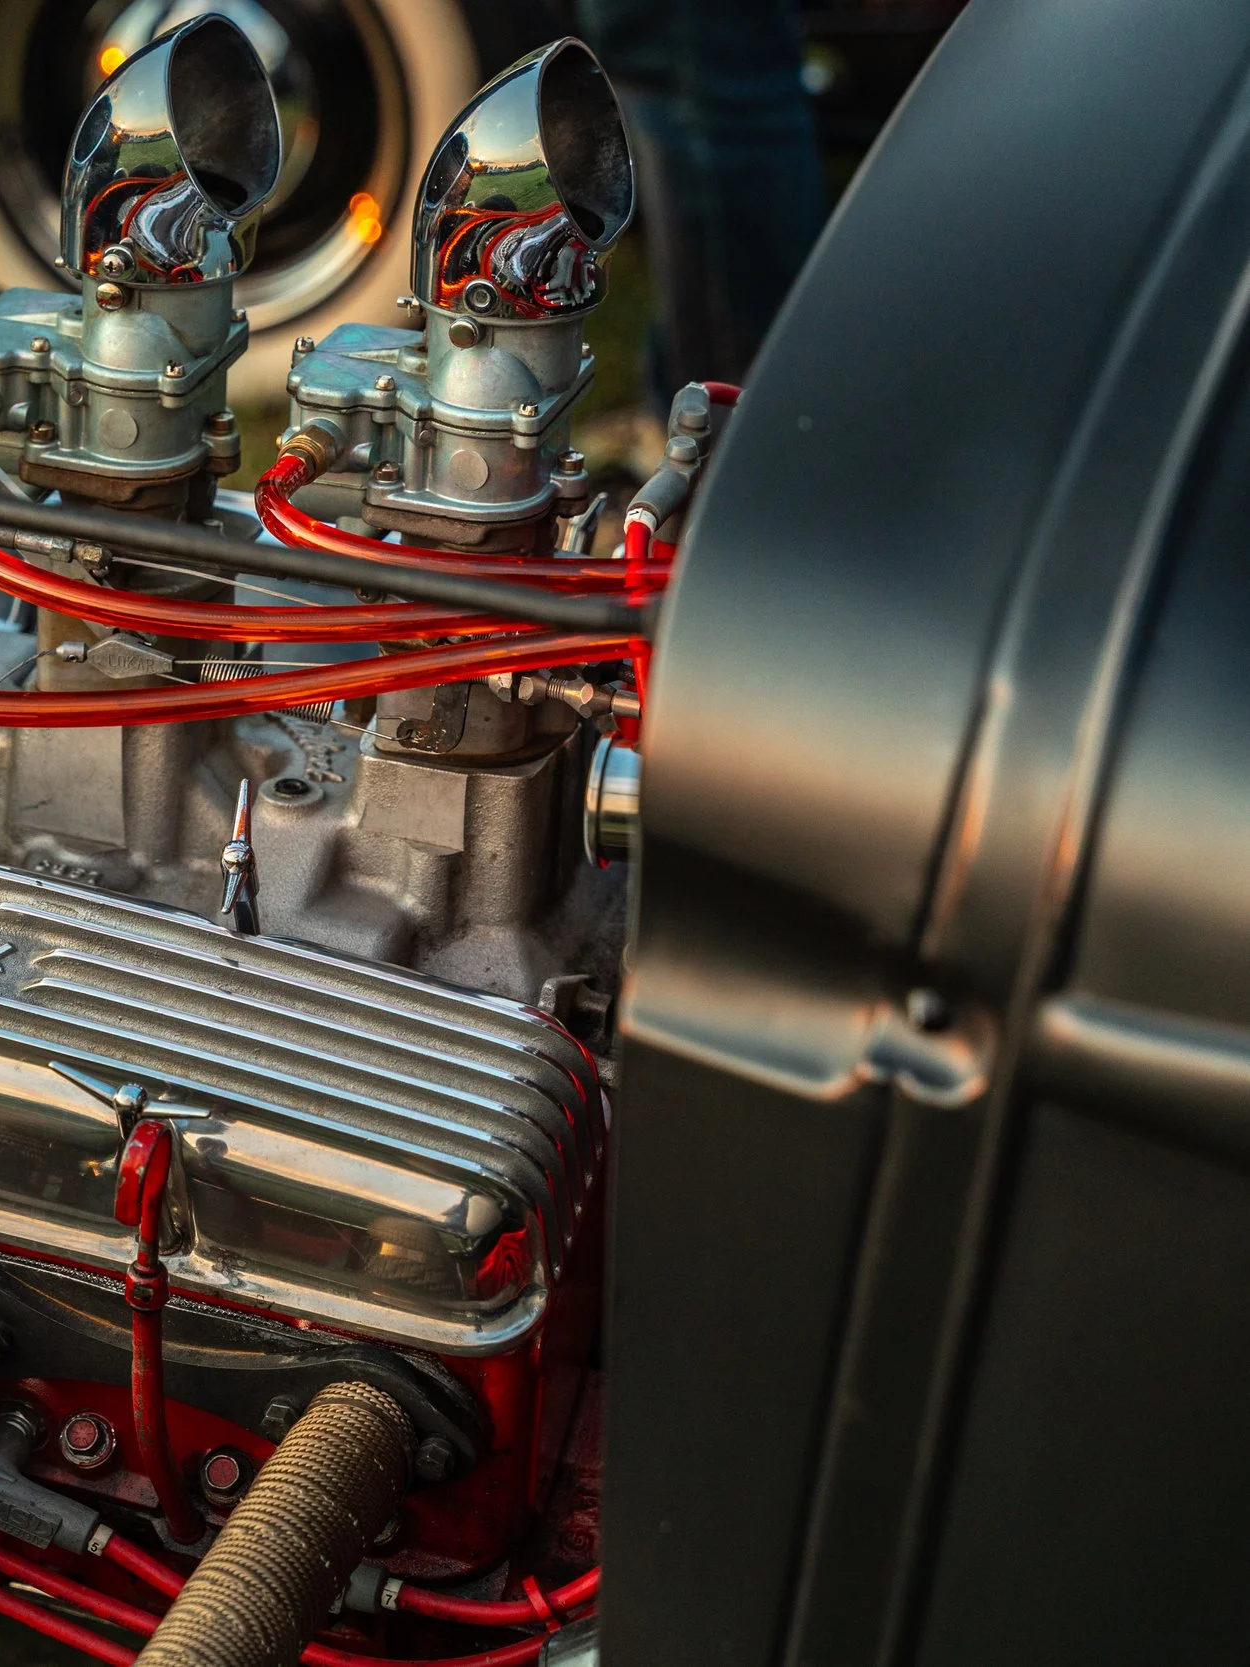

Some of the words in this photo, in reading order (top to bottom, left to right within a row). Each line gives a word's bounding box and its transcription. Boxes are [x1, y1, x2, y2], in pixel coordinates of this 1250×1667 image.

[107, 653, 156, 672] LOKAR
[90, 1542, 100, 1553] 5
[385, 1593, 393, 1606] 7
